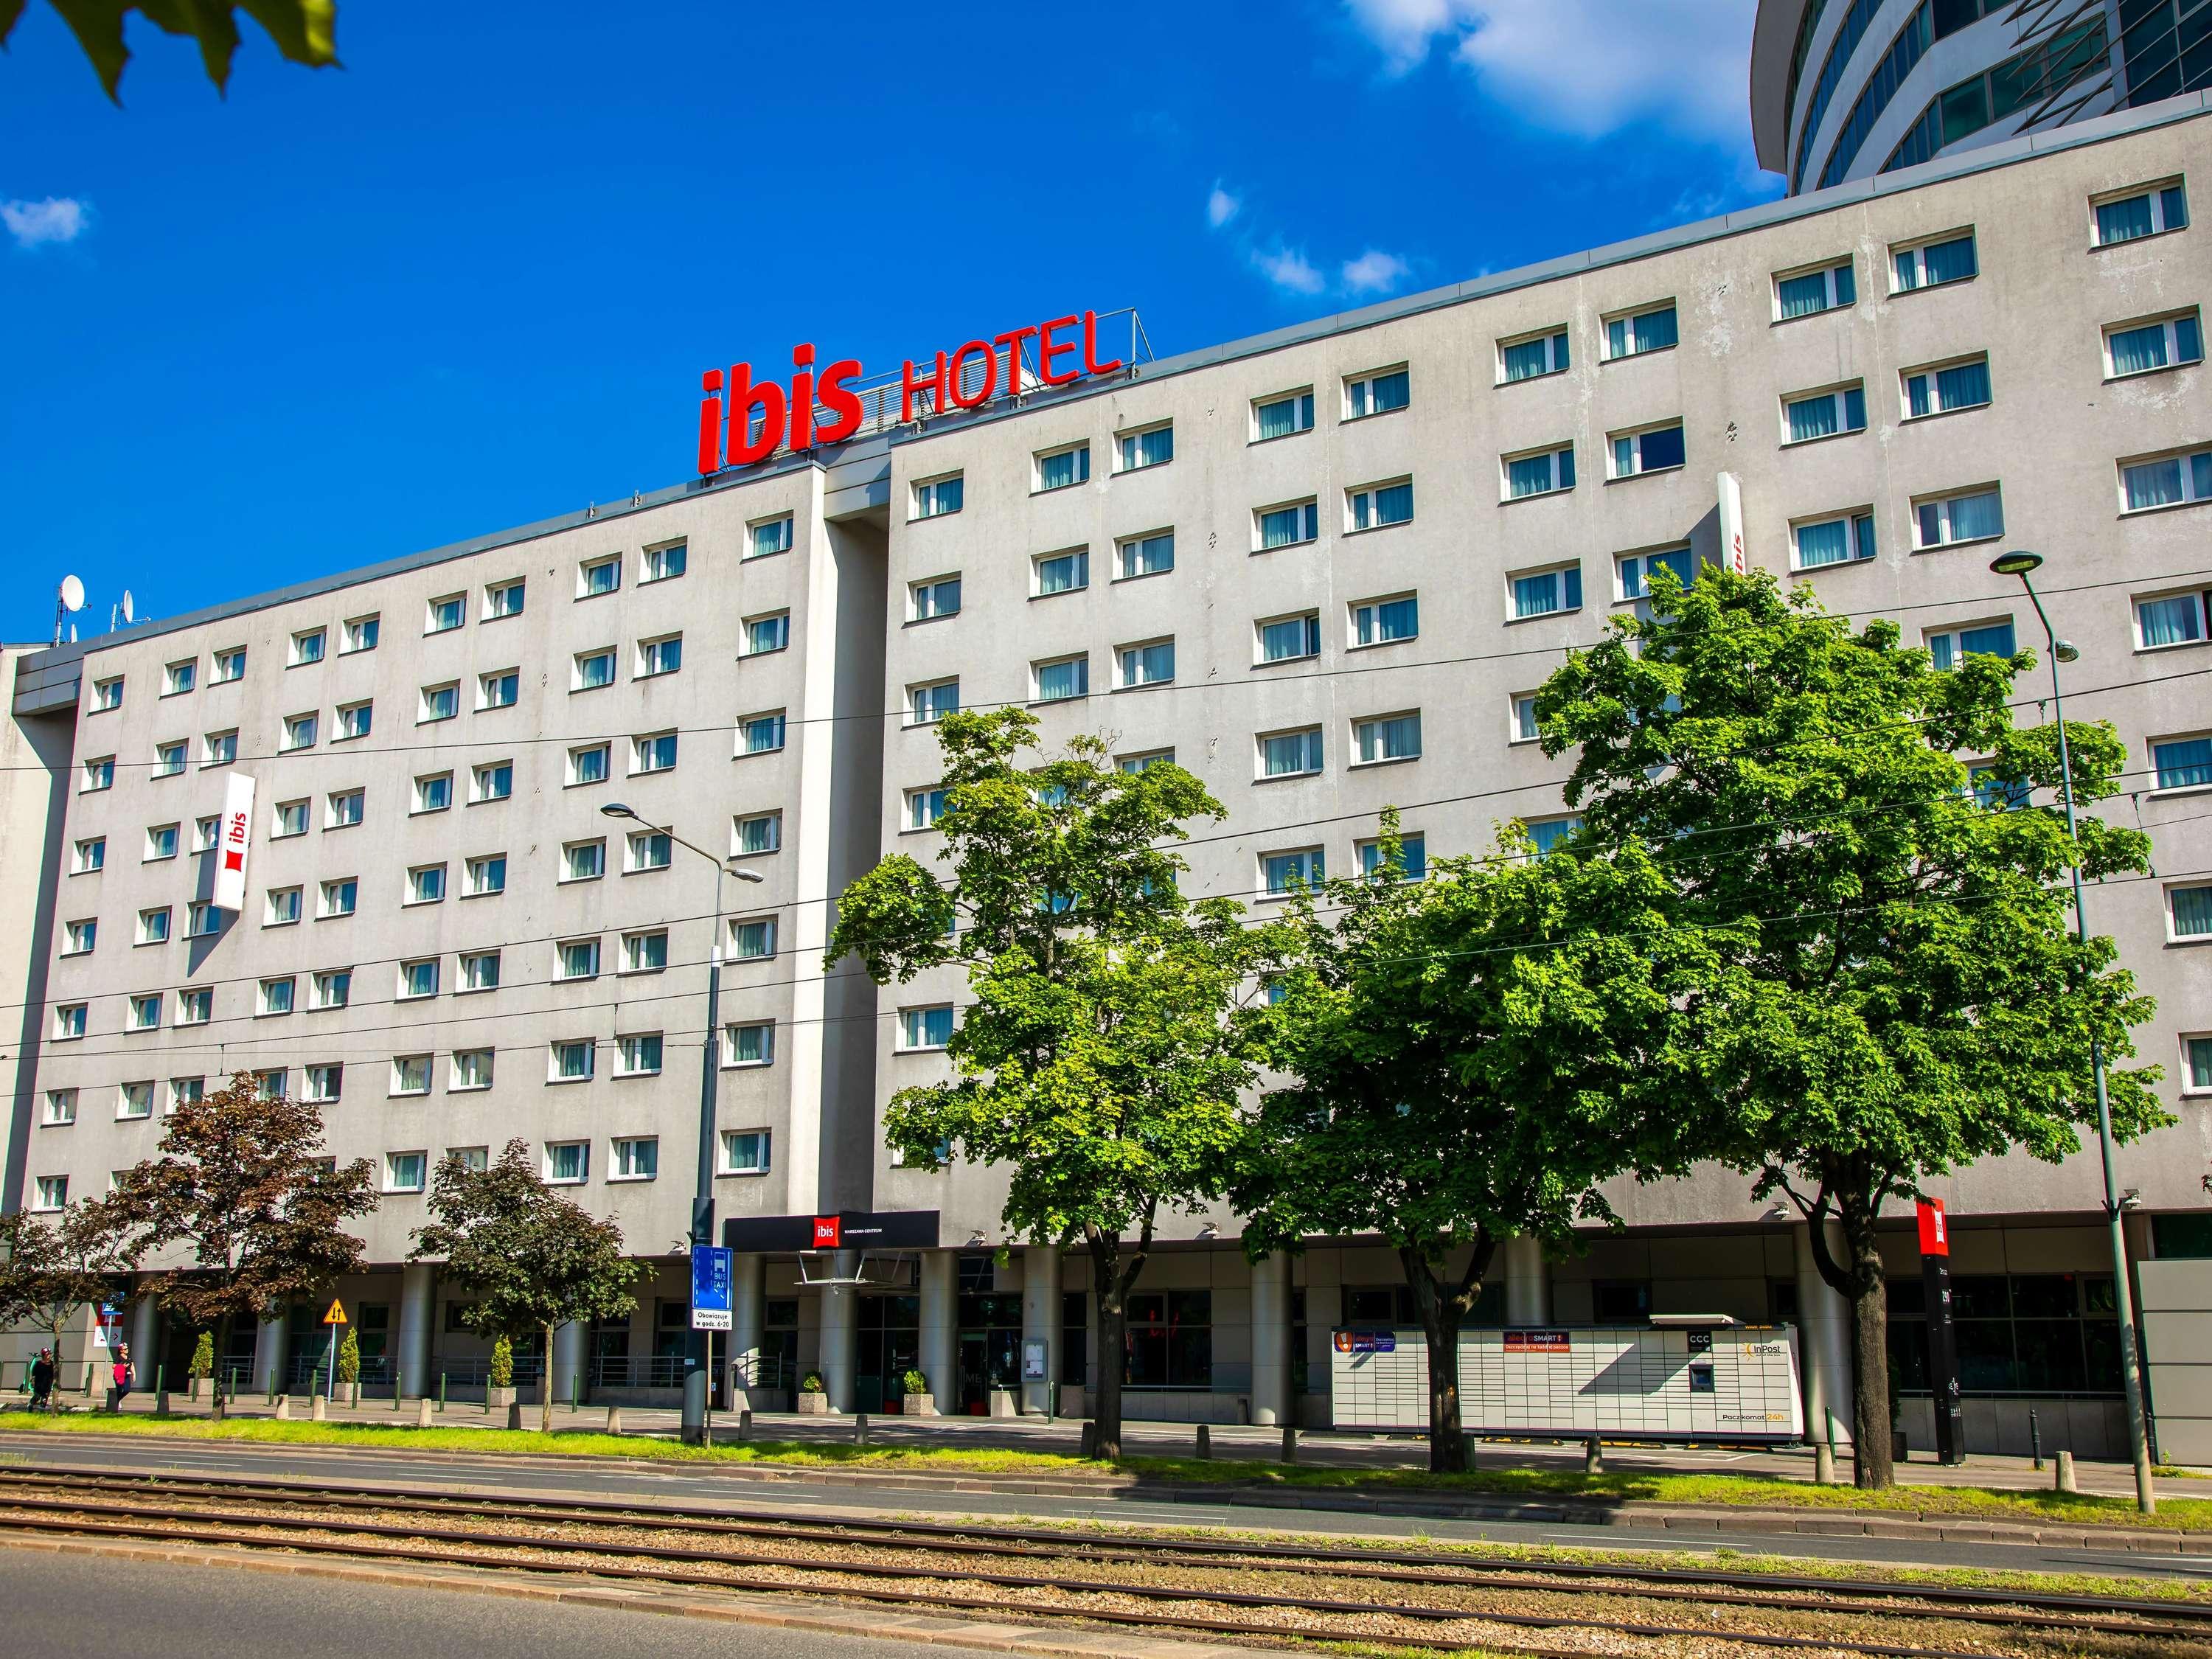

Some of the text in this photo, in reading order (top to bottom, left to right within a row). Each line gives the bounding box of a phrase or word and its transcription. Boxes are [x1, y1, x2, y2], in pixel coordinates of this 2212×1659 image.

[698, 310, 1122, 476] ibis HOTEL
[229, 812, 246, 844] ibis
[817, 1225, 834, 1237] ibis
[1754, 1345, 1781, 1354] InPost
